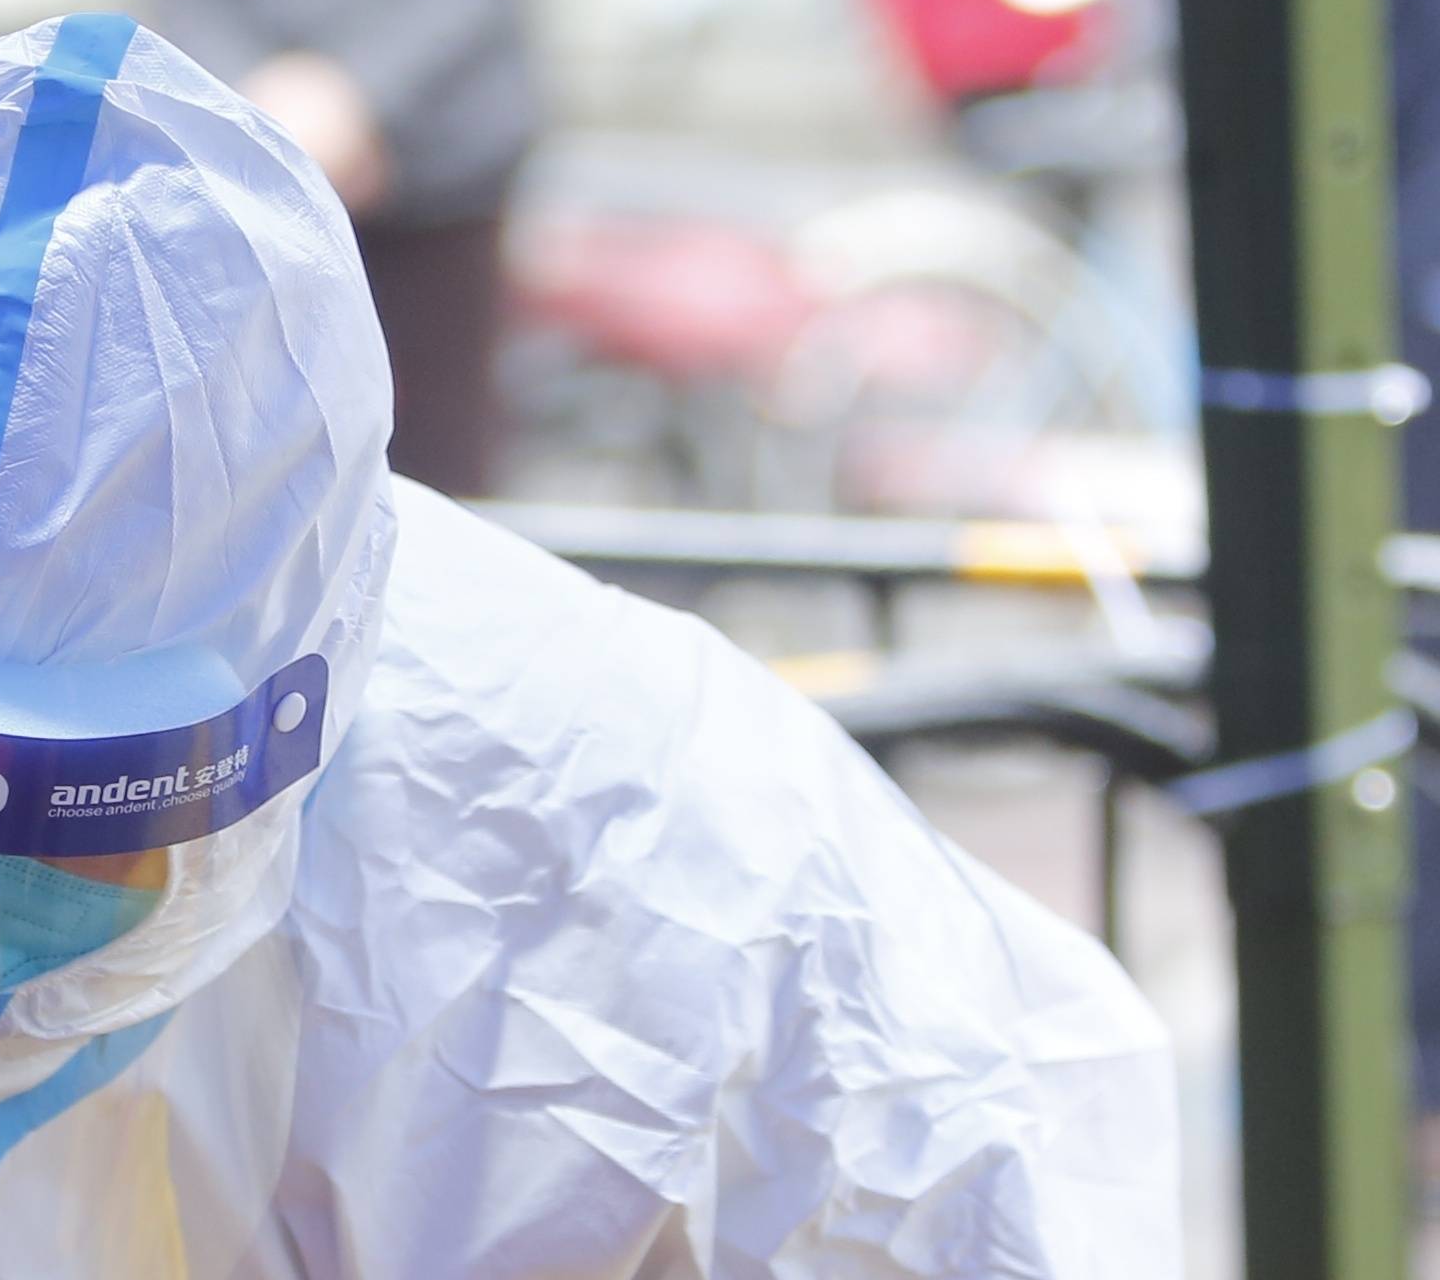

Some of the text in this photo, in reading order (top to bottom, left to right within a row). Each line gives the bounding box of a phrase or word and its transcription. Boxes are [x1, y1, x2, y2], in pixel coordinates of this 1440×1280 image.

[50, 745, 249, 806] andent 安登特
[48, 806, 103, 818] choose
